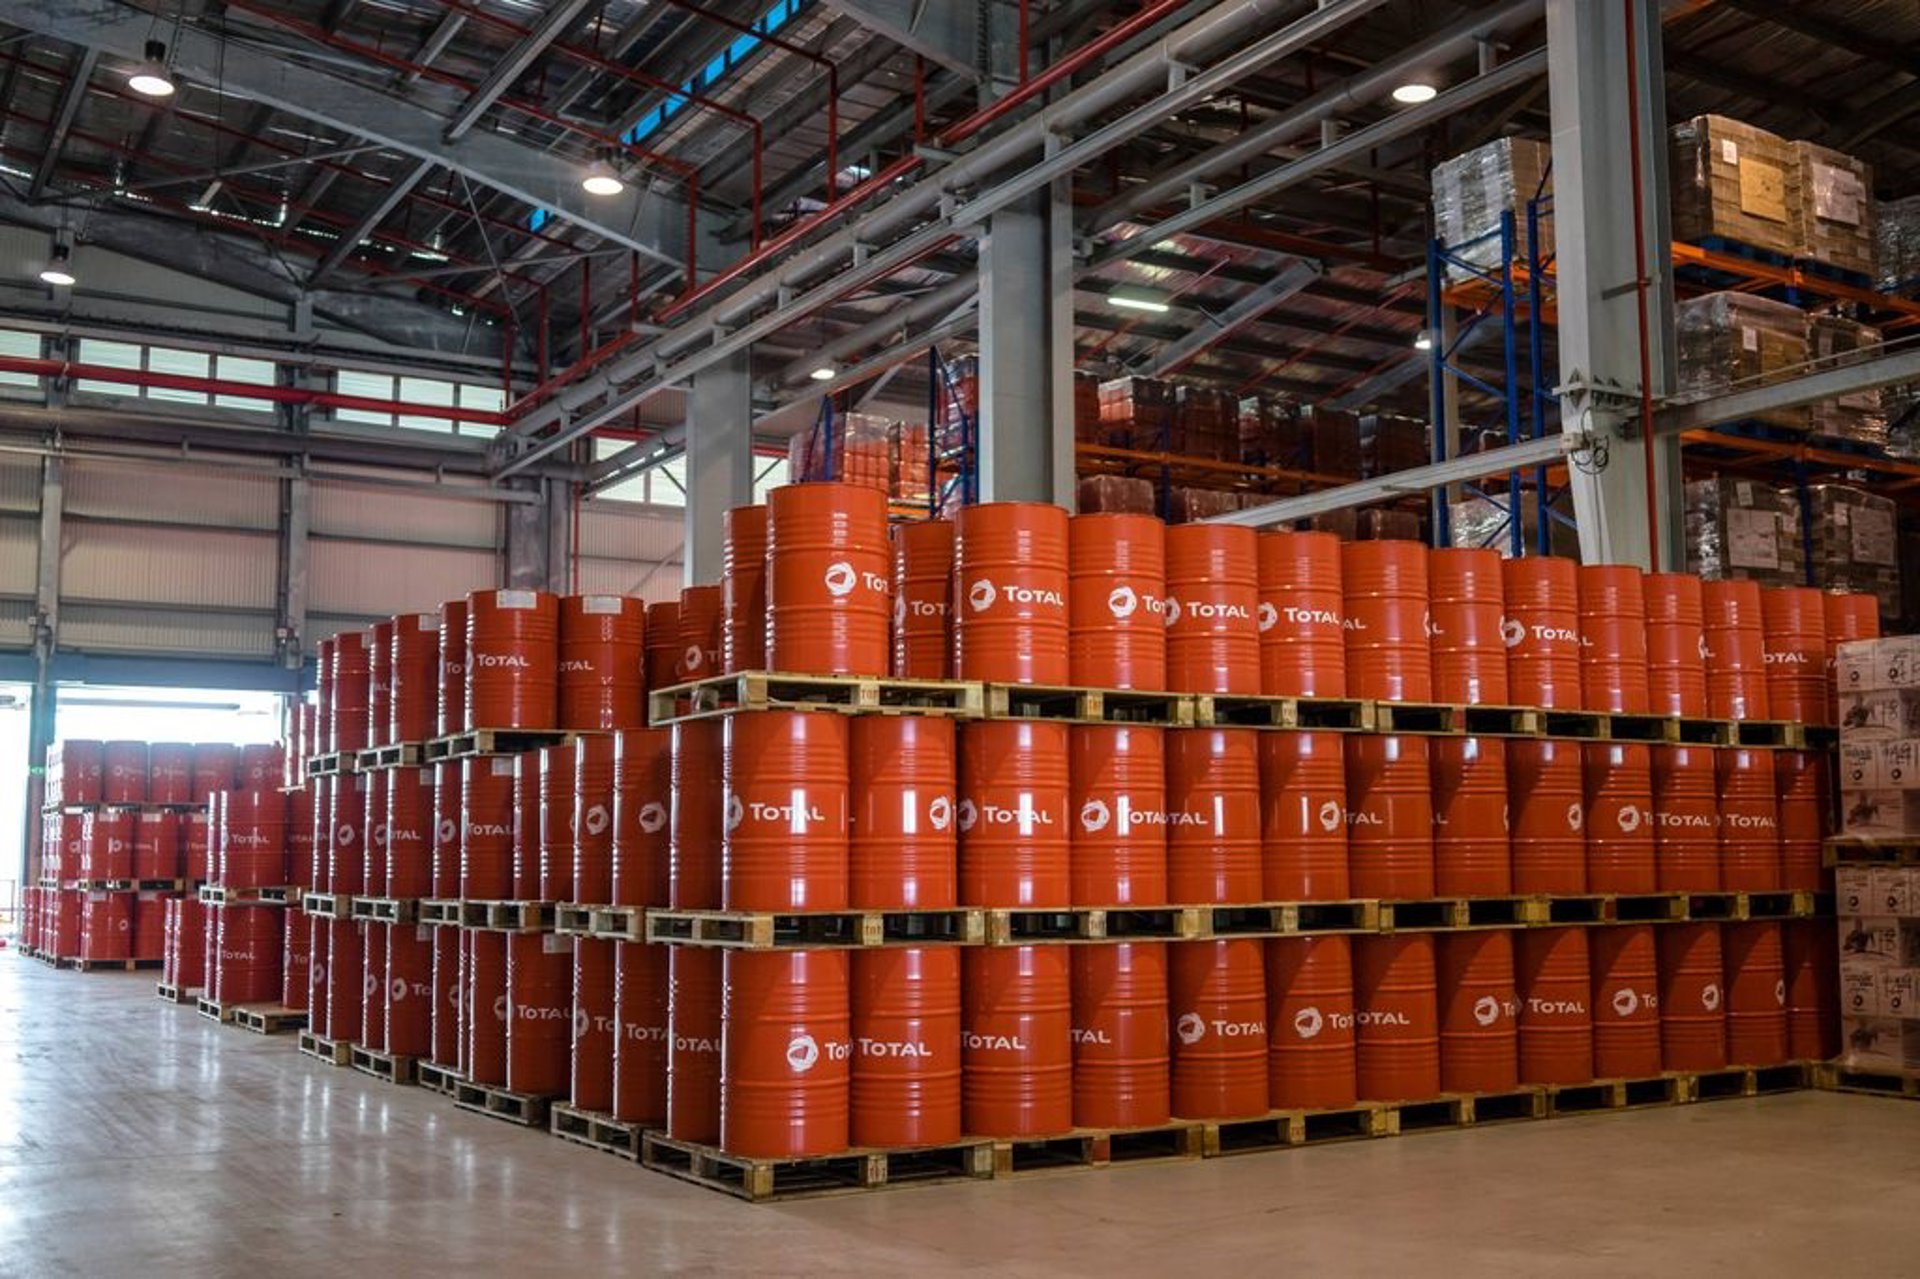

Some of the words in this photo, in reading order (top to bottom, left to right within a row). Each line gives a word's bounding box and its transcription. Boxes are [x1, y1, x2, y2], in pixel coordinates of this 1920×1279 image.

[862, 572, 888, 591] TOT
[1002, 586, 1063, 606] TOTAL
[1142, 596, 1166, 613] TOT
[1187, 602, 1250, 619] TOTAL
[1284, 607, 1341, 625] TOTAL
[1531, 625, 1578, 642] TOTAL
[477, 654, 531, 668] TOTAL
[559, 660, 595, 671] OTAL
[1347, 812, 1383, 825] TAL
[1657, 812, 1711, 826] TOTAL
[1726, 813, 1776, 828] TOTAL
[1528, 998, 1586, 1014] TOTAL
[1356, 1011, 1410, 1025] OTAL
[1072, 1028, 1111, 1044] TAL
[1211, 1020, 1265, 1036] TOTAL
[859, 1038, 932, 1057] TOTAL
[961, 1031, 1026, 1051] TOTAL
